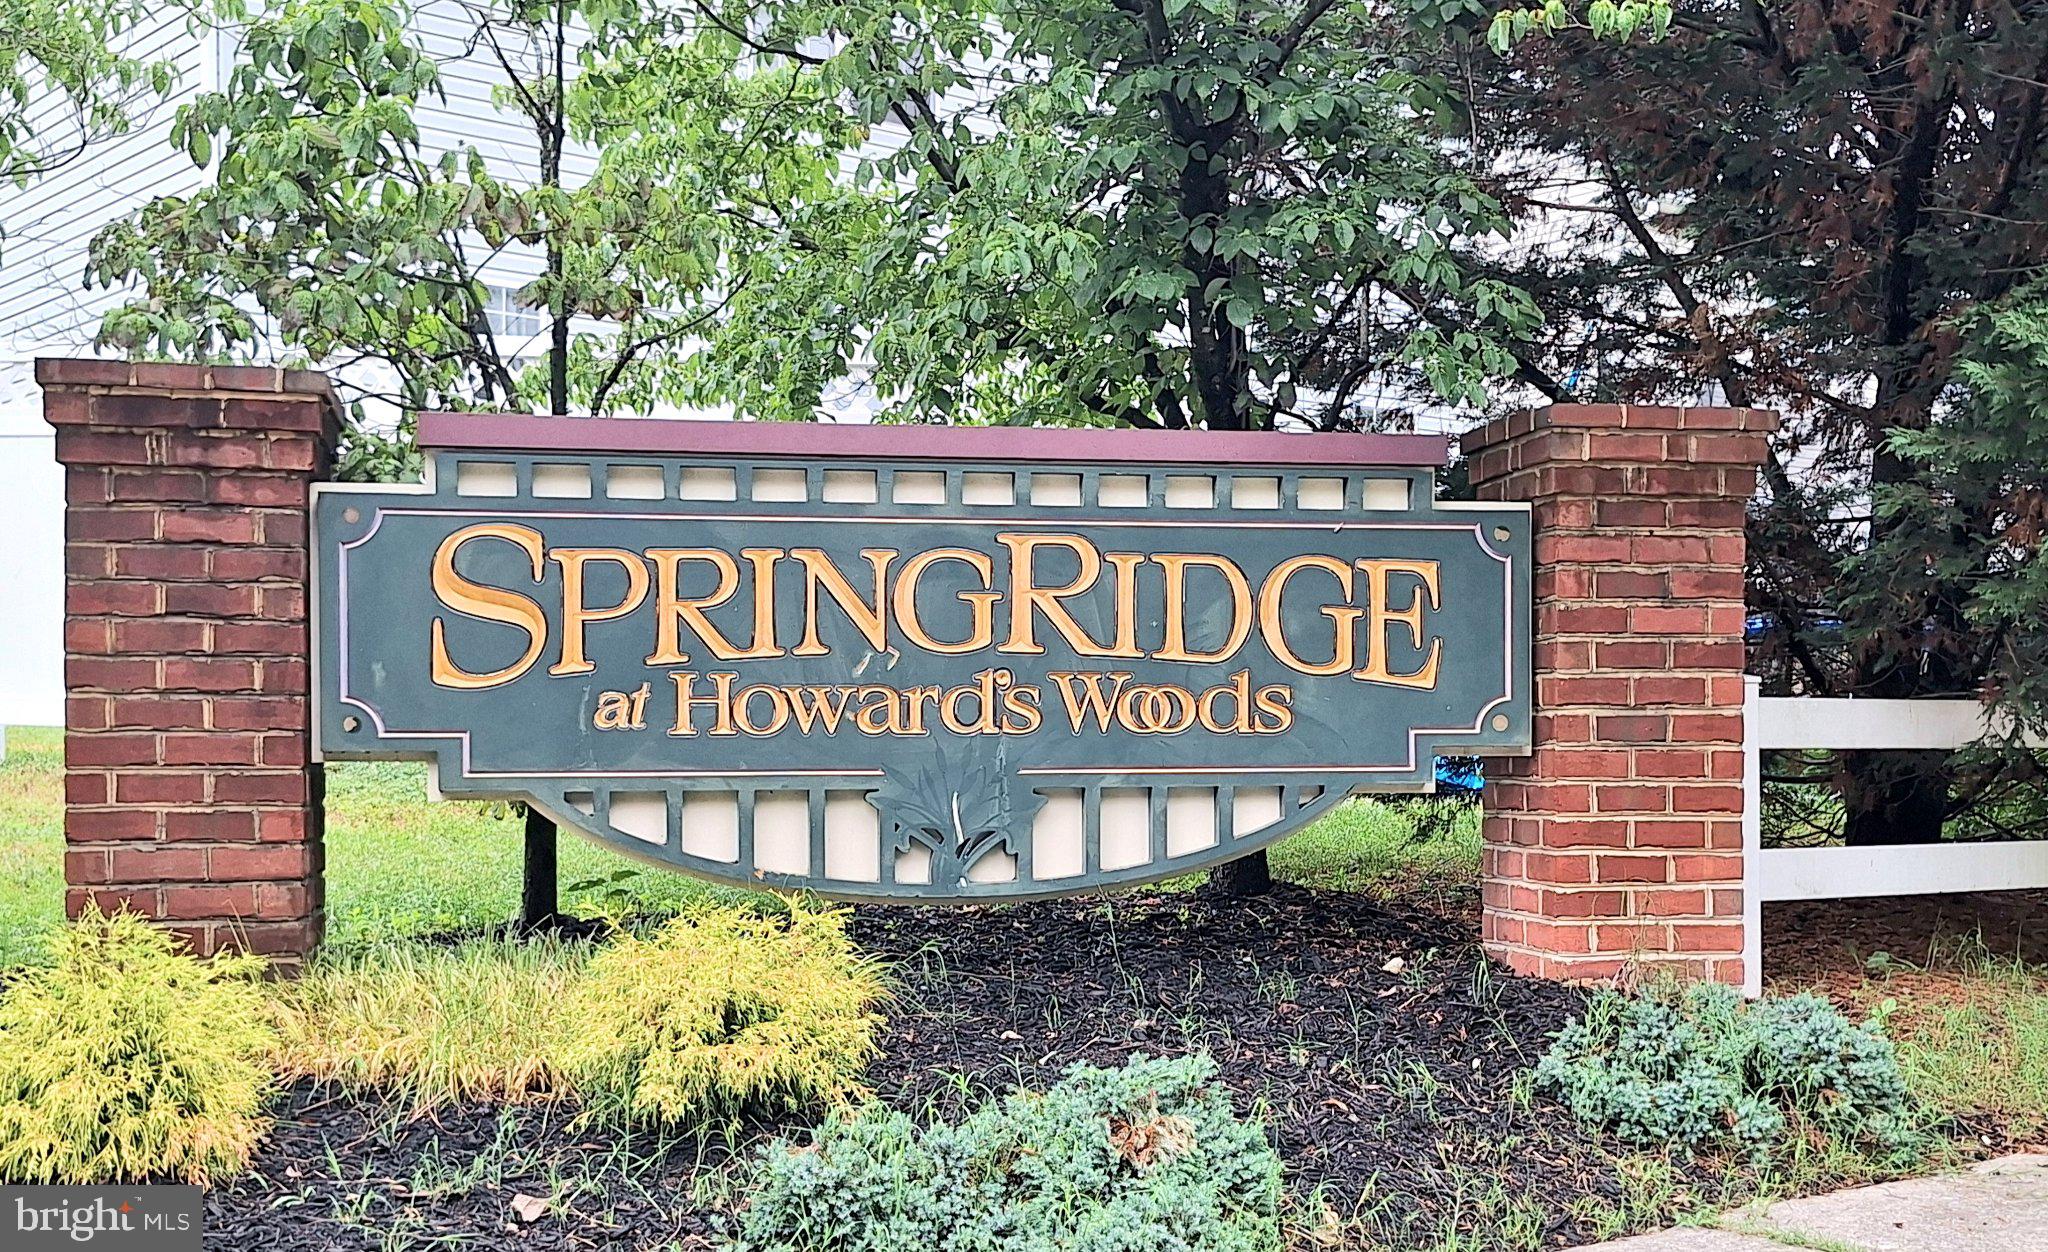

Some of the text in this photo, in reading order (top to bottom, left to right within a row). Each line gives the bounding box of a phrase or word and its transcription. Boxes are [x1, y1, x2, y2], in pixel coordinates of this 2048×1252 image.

[431, 523, 1441, 690] SPRINGRIDGE
[593, 668, 1294, 738] at Howard's Woods
